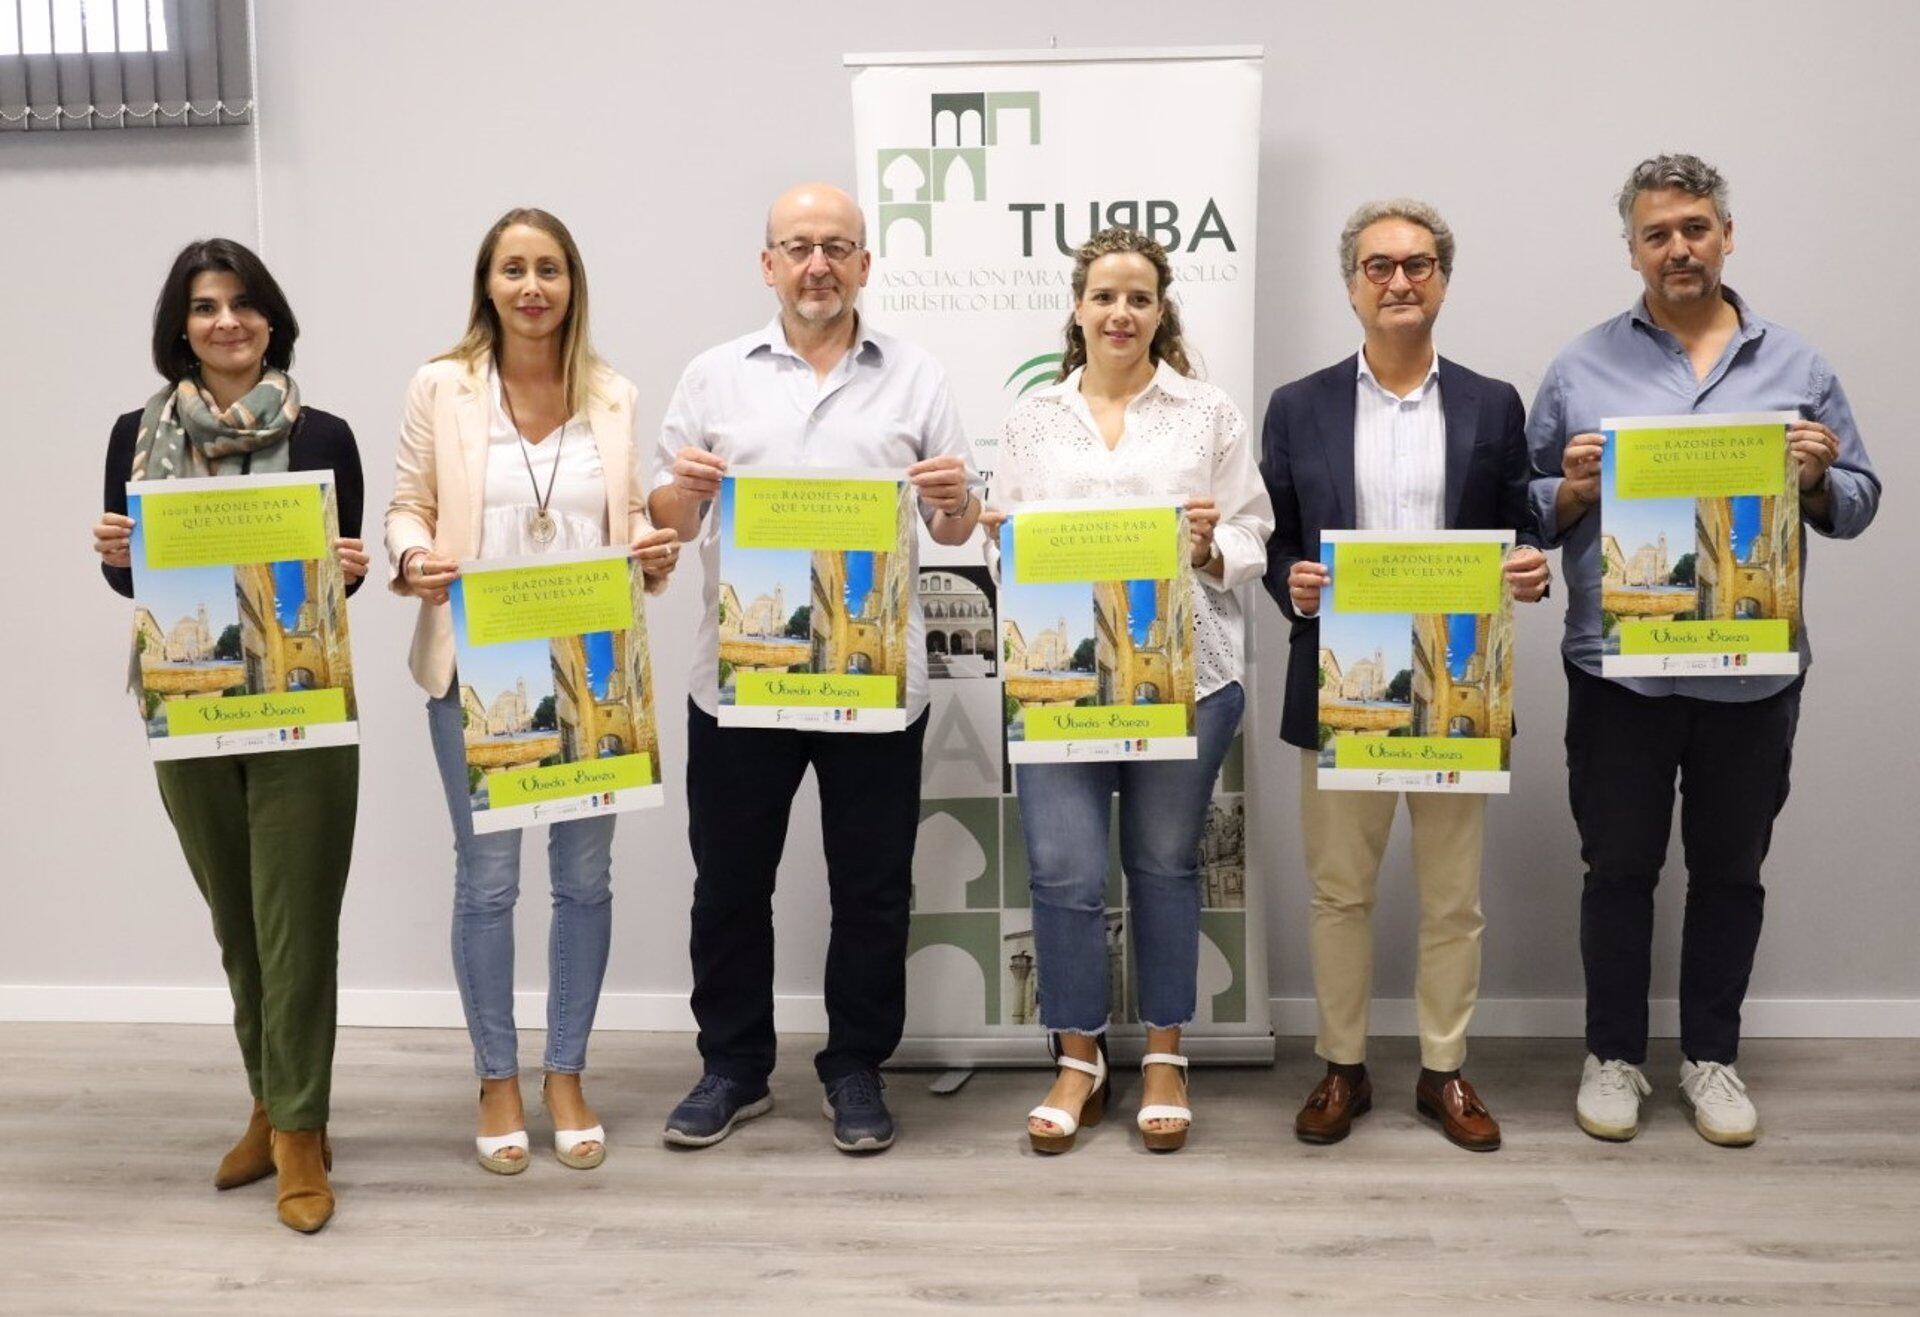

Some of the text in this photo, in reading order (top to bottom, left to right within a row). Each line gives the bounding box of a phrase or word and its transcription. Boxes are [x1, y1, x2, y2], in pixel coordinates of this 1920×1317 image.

[881, 268, 1004, 288] ASOCIACIÓN
[1013, 269, 1065, 286] PARA
[881, 291, 986, 312] TURÍSTICO
[993, 294, 1022, 311] DE
[1664, 439, 1725, 450] RAZONES
[1730, 437, 1764, 447] PARA
[1653, 450, 1747, 463] QUE VUELVAS
[782, 491, 840, 500] RAZONES
[844, 492, 878, 502] PARA
[194, 501, 258, 514] RAZONES
[263, 499, 300, 510] PARA
[771, 504, 860, 513] QUE VUELVAS
[183, 514, 282, 529] QUE VUELVAS
[1060, 523, 1120, 533] RAZONES
[1123, 521, 1157, 530] PARA
[1050, 534, 1139, 547] QUE VUELVAS
[1382, 555, 1440, 564] RAZONES
[1446, 555, 1481, 564] PARA
[1372, 568, 1463, 577] QUE VUELVAS
[512, 576, 572, 590] RAZONES
[576, 572, 610, 584] PARA
[502, 587, 595, 605] QUE VUELVAS
